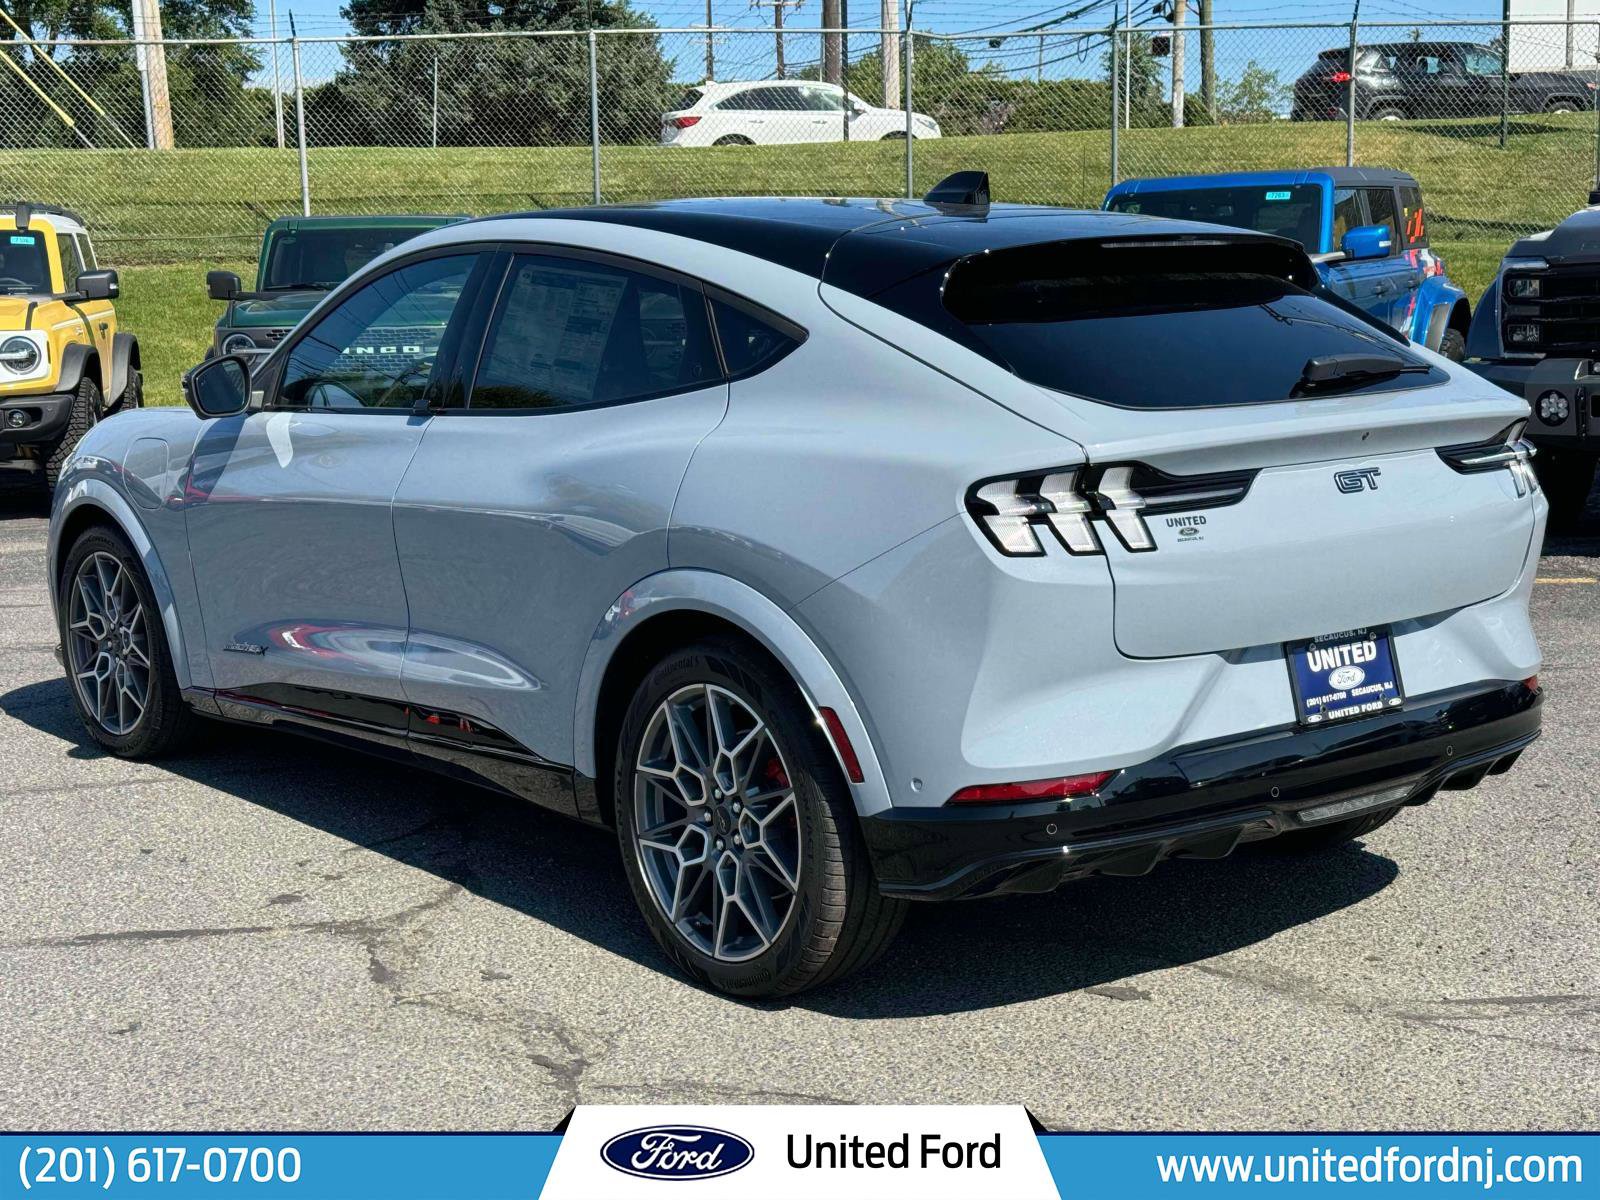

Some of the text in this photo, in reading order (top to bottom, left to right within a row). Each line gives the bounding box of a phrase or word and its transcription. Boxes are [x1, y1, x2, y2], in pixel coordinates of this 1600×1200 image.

[1333, 466, 1381, 495] GT
[1165, 515, 1207, 528] UNITED
[1357, 628, 1367, 636] NJ
[1306, 641, 1377, 672] UNITED
[1328, 707, 1360, 719] UNITED
[1361, 701, 1383, 712] FORD
